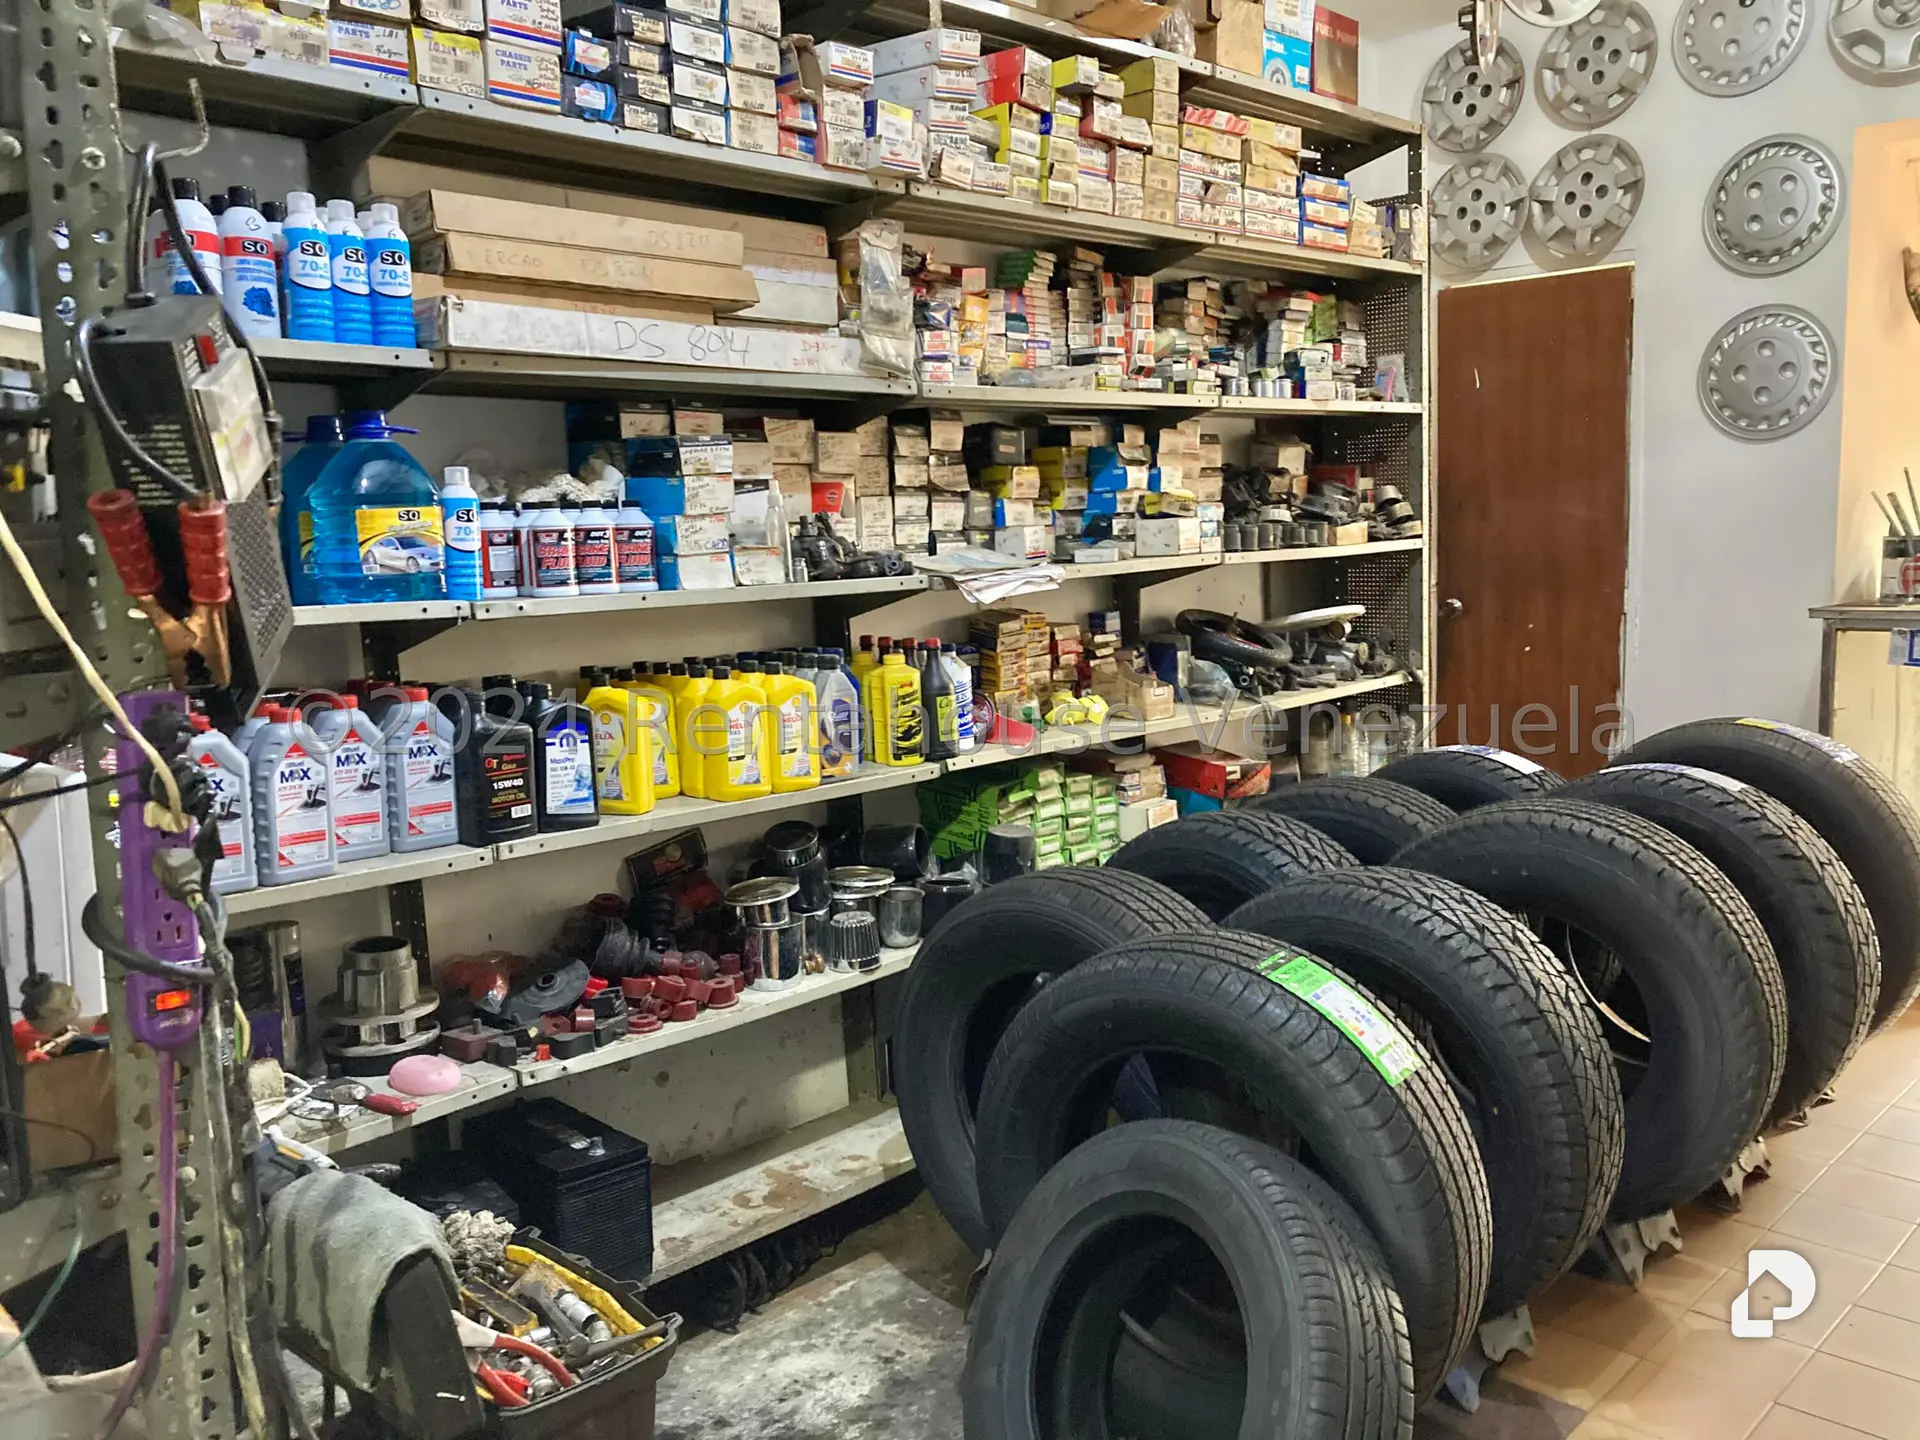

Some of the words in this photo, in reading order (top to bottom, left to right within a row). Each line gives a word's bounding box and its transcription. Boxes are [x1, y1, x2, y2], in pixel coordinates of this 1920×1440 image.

[337, 26, 370, 39] PARTS
[1315, 21, 1334, 39] FUEL
[495, 48, 532, 63] CHASSIS
[500, 58, 529, 71] PARTS
[243, 240, 268, 255] SQ
[301, 240, 326, 256] SQ
[382, 250, 406, 266] SQ
[613, 320, 666, 358] DS
[687, 324, 751, 366] 804
[399, 510, 420, 521] SQ
[592, 730, 614, 740] ELIX
[407, 743, 439, 760] MAX
[335, 751, 367, 768] MAX
[280, 766, 311, 784] MAX
[493, 778, 524, 790] 15W40
